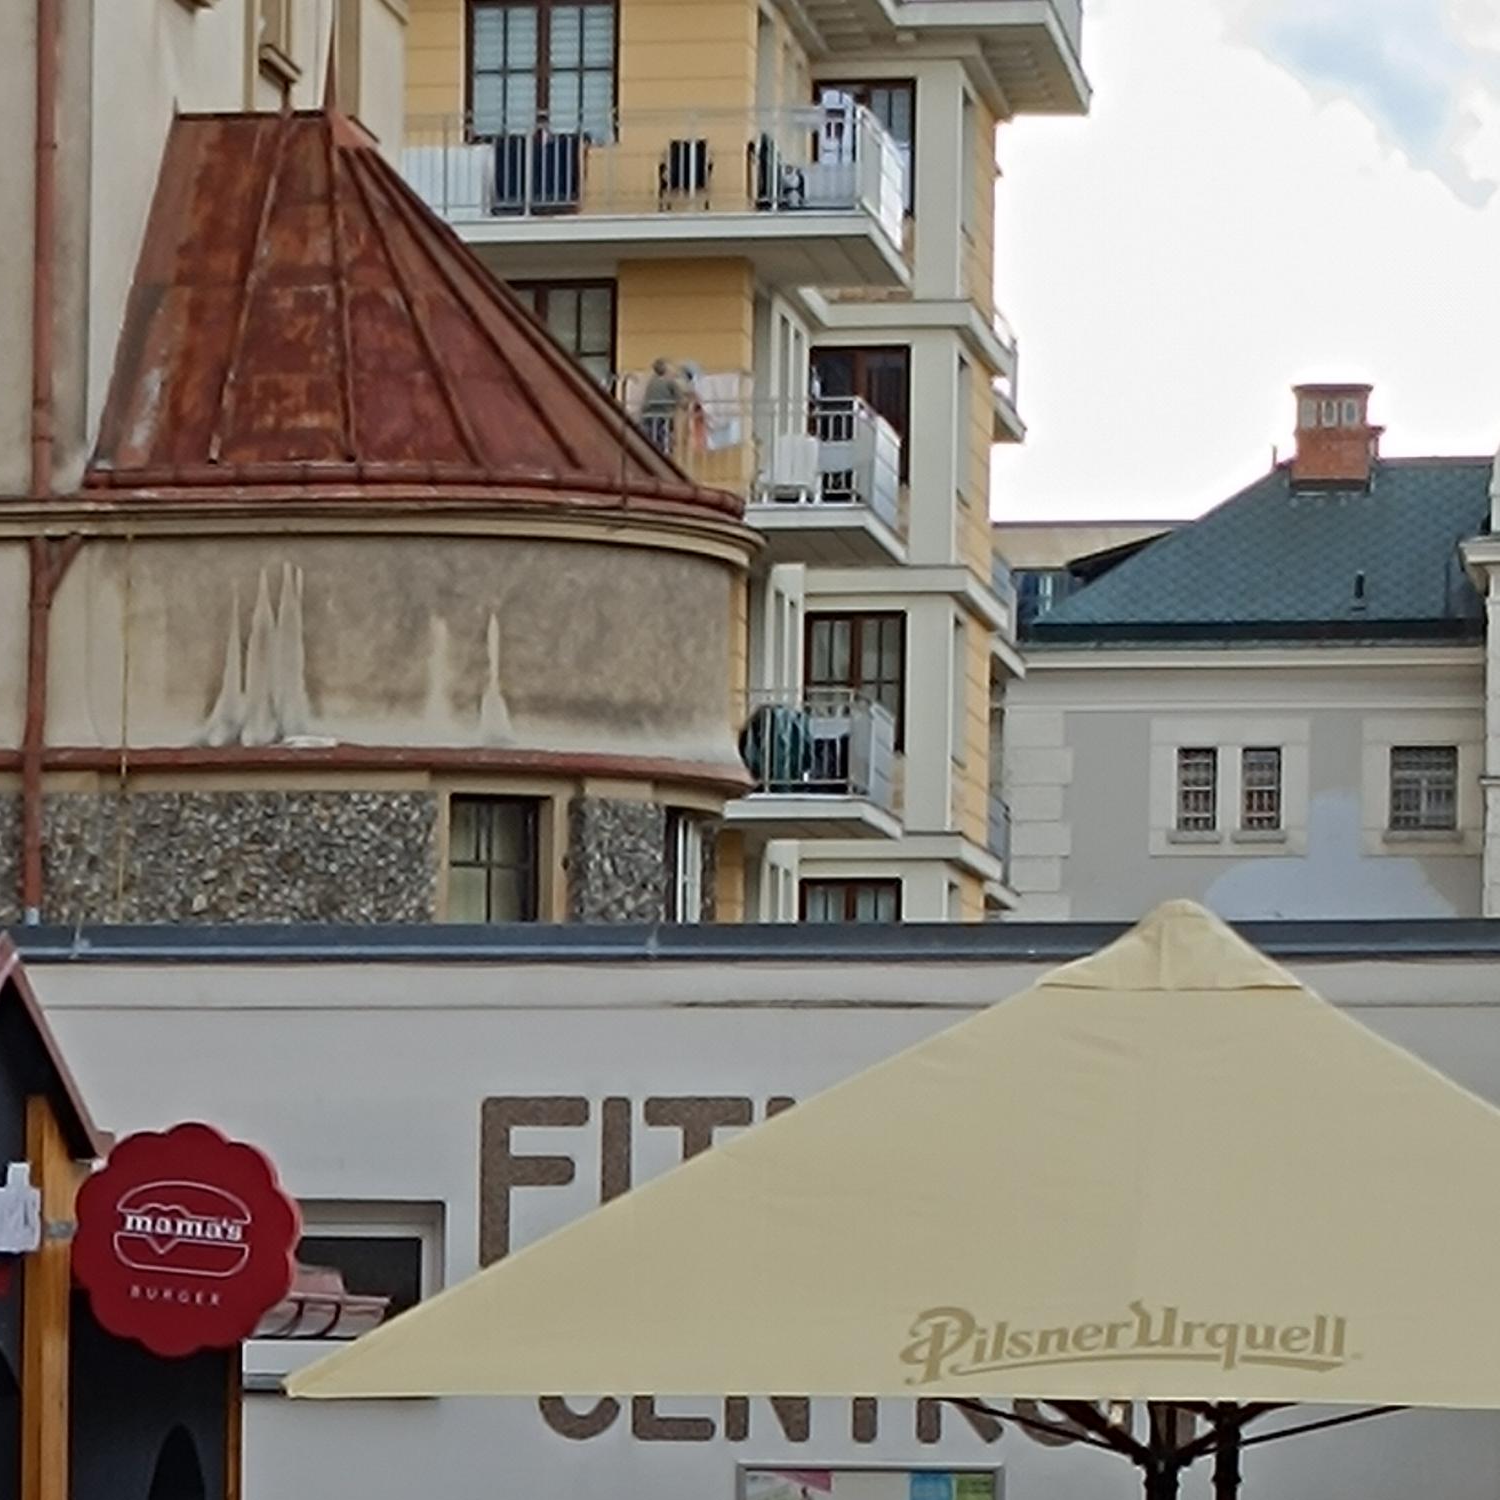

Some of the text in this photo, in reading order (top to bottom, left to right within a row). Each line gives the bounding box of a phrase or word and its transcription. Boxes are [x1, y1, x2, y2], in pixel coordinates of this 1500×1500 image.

[479, 1096, 796, 1269] FIT
[125, 1213, 243, 1241] mama's
[130, 1285, 220, 1305] BURGER
[900, 1300, 1347, 1384] Pilsner Urquell
